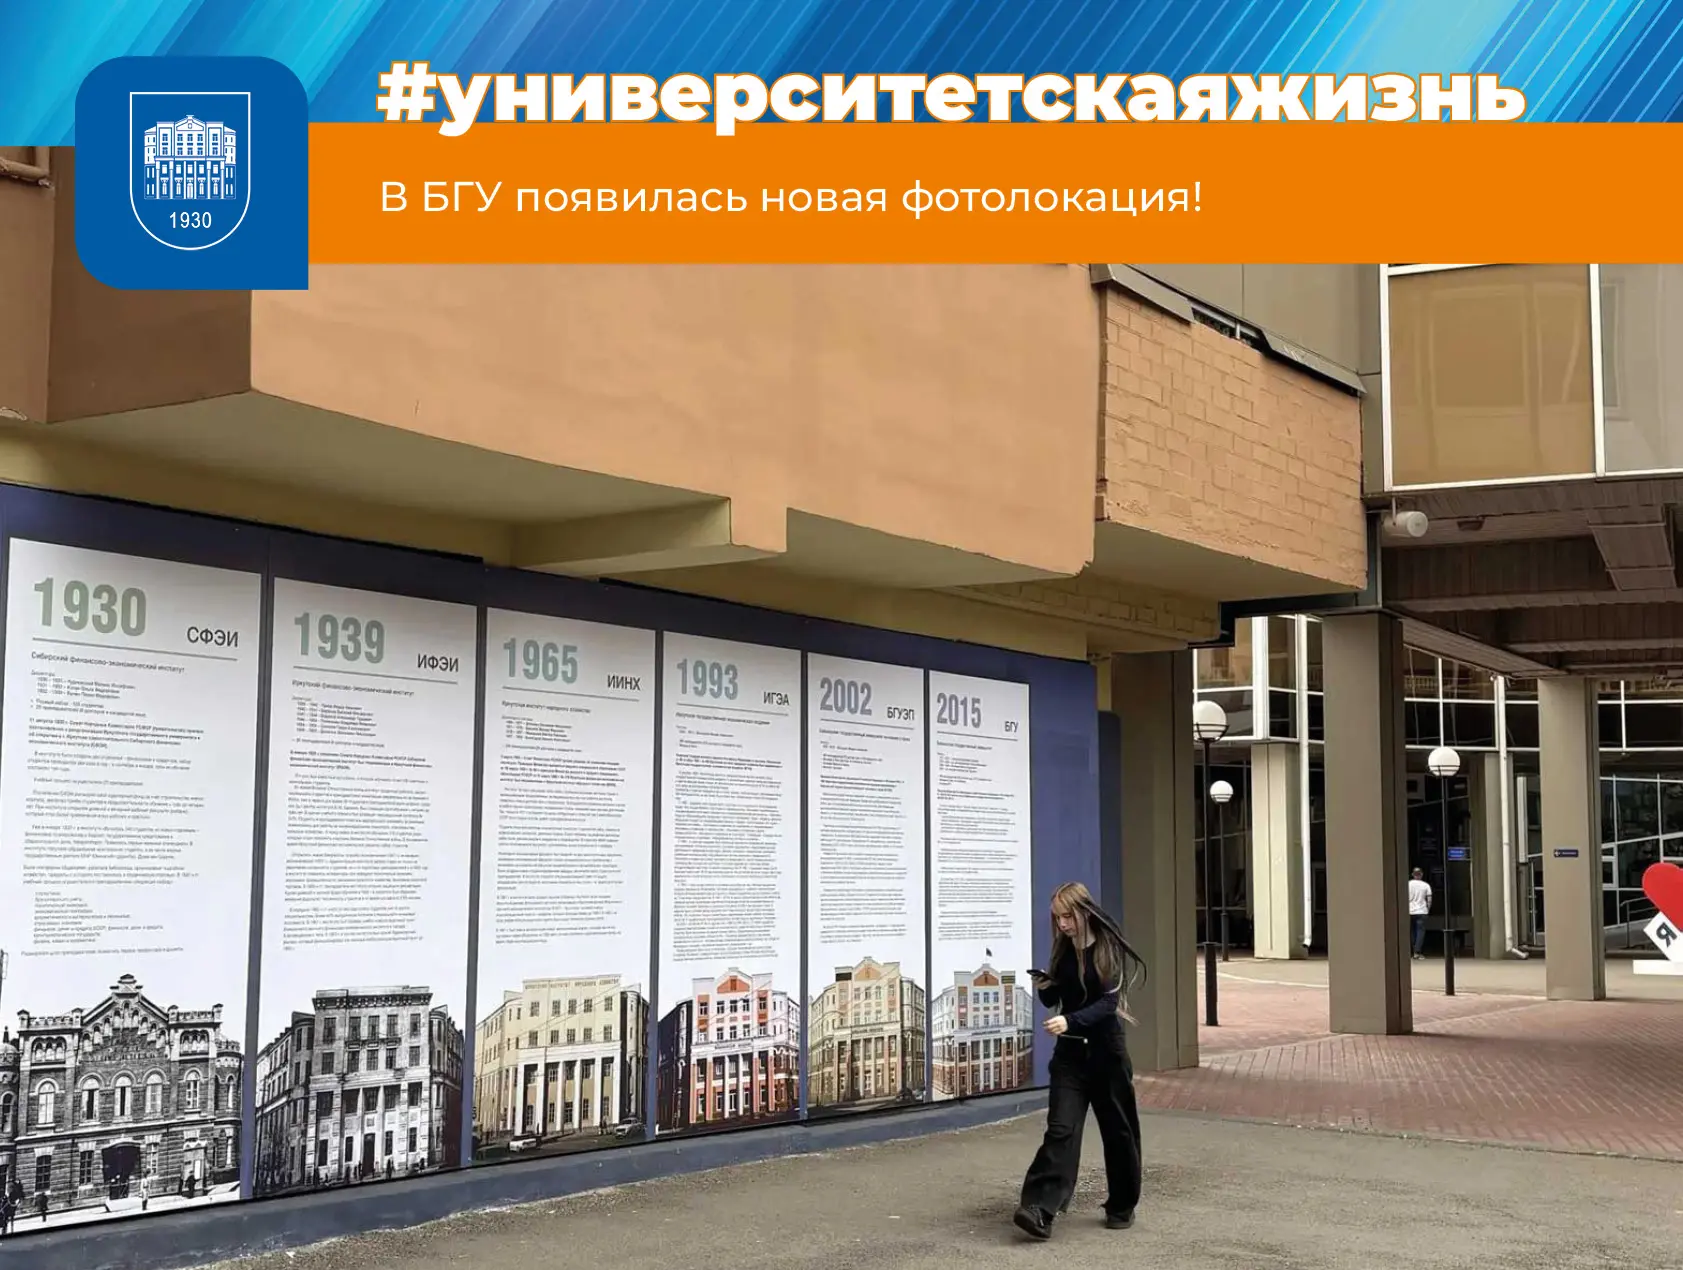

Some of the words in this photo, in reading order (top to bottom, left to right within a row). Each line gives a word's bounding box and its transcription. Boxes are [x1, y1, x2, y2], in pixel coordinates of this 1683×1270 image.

[33, 577, 147, 637] 1930
[186, 625, 239, 648] СФЭИ
[294, 612, 385, 664] 1939
[417, 652, 459, 674] ИФЭИ
[503, 637, 578, 684] 1965
[607, 674, 641, 692] ИИНХ
[677, 658, 739, 701] 1993
[763, 690, 790, 707] ИГЭА
[820, 677, 873, 717] 2002
[937, 692, 982, 729] 2015
[887, 705, 915, 722] БГУЭП
[1005, 720, 1019, 734] БГУ
